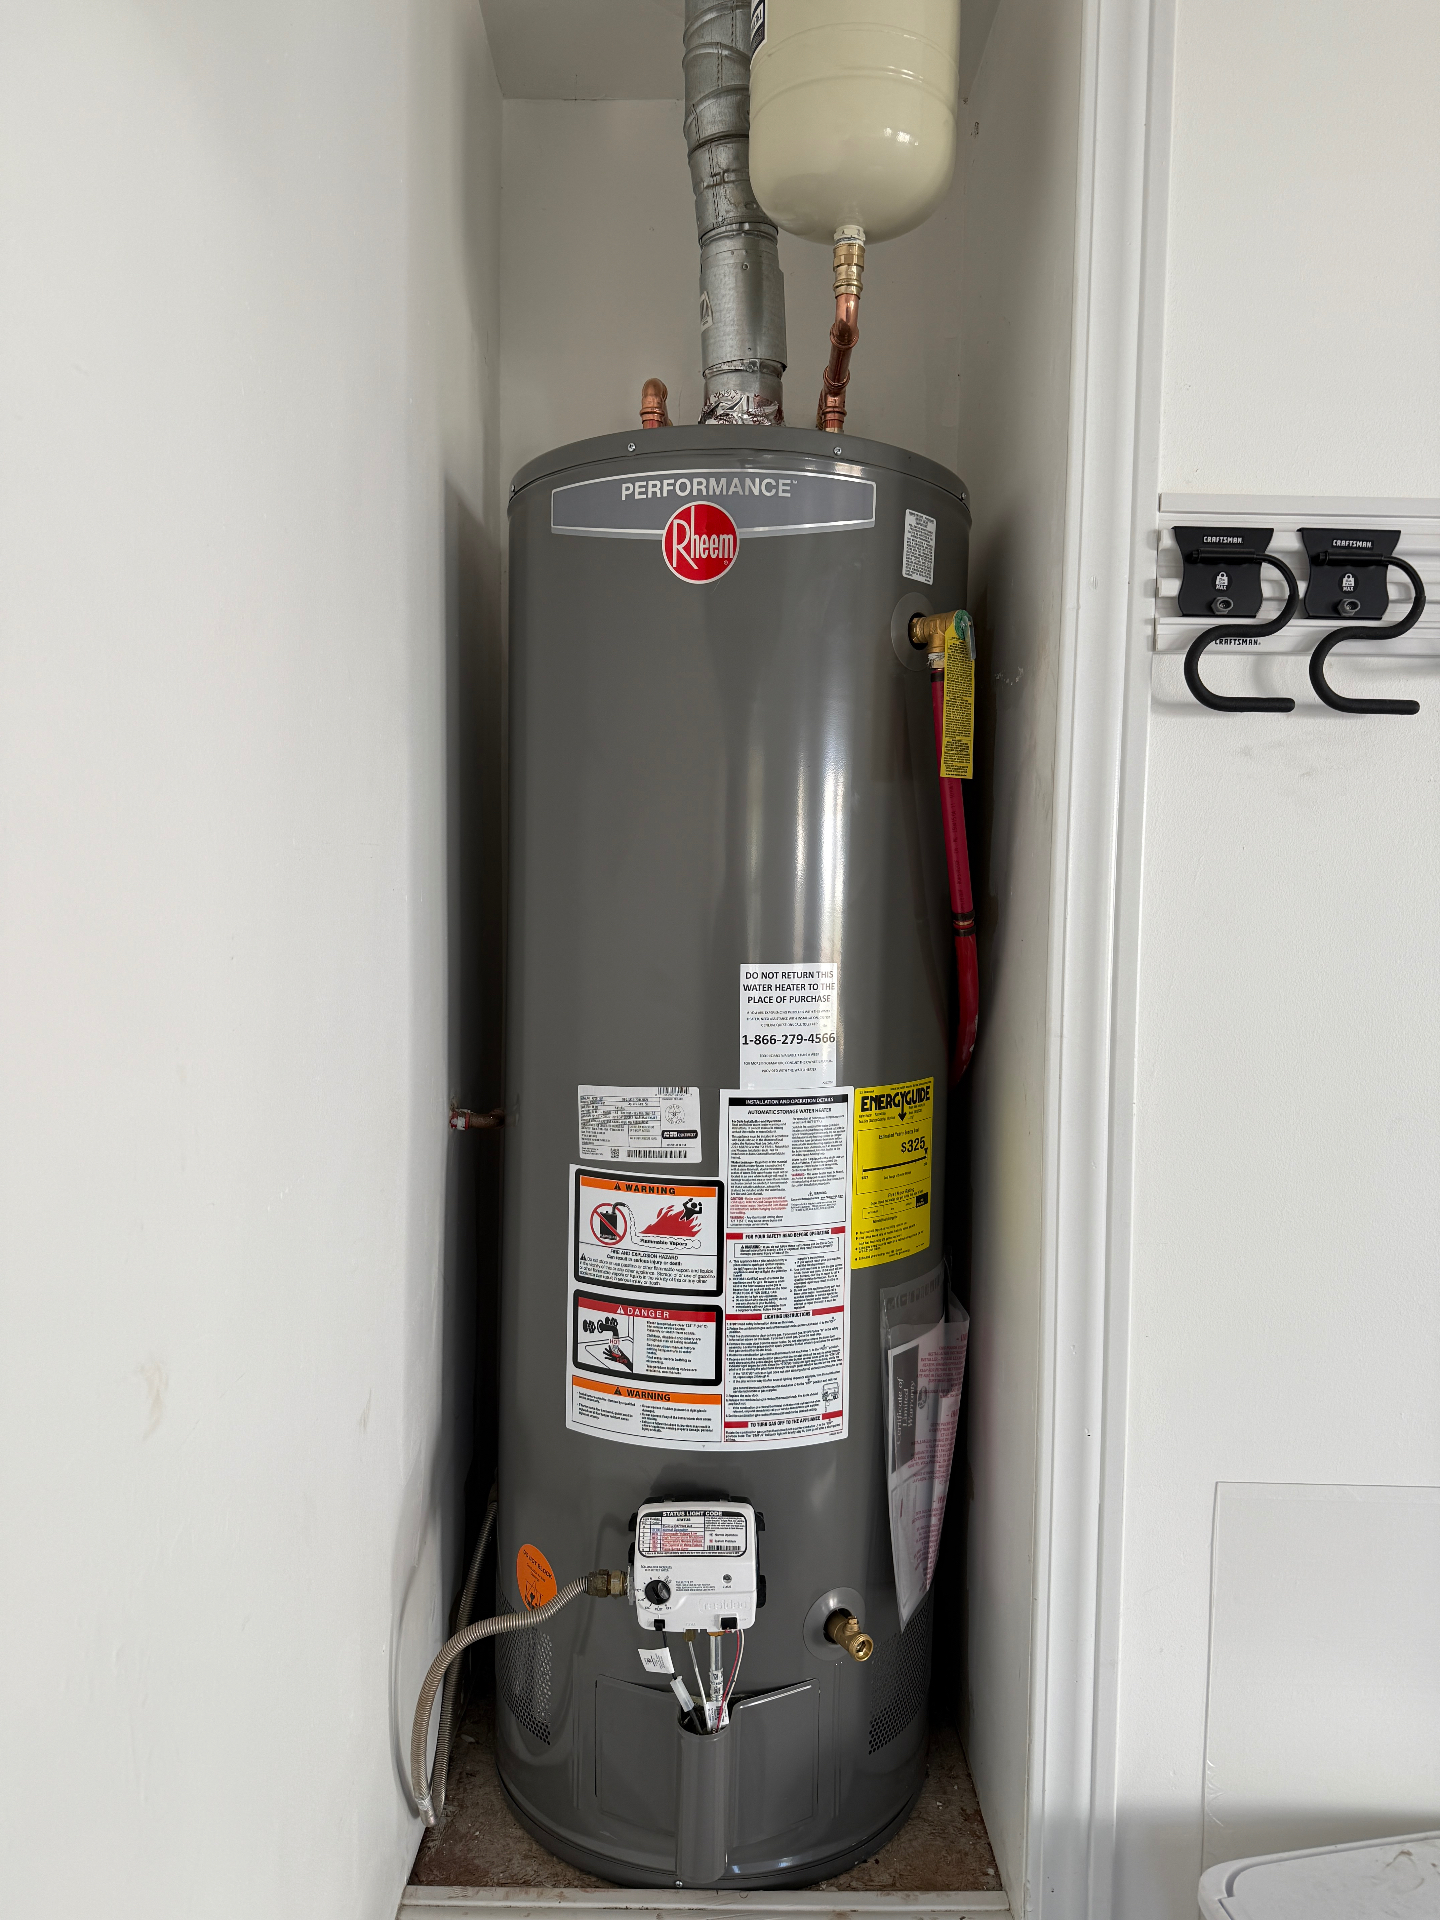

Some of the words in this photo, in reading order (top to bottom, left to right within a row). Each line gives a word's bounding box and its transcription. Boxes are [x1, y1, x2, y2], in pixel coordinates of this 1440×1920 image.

[621, 477, 792, 500] PERFORMANCE
[672, 505, 734, 570] Rheem
[1203, 536, 1244, 544] CRAFTSMAN
[1332, 540, 1372, 548] CRAFTSMAN
[745, 972, 758, 980] DO
[790, 995, 831, 1003] PURCHASE
[742, 1033, 836, 1045] 1-866-279-4566
[860, 1086, 930, 1112] ENERGYGUIDE
[901, 1136, 926, 1154] $325
[625, 1184, 676, 1195] WARNING
[627, 1308, 670, 1318] DANGER
[626, 1389, 670, 1401] WARNING
